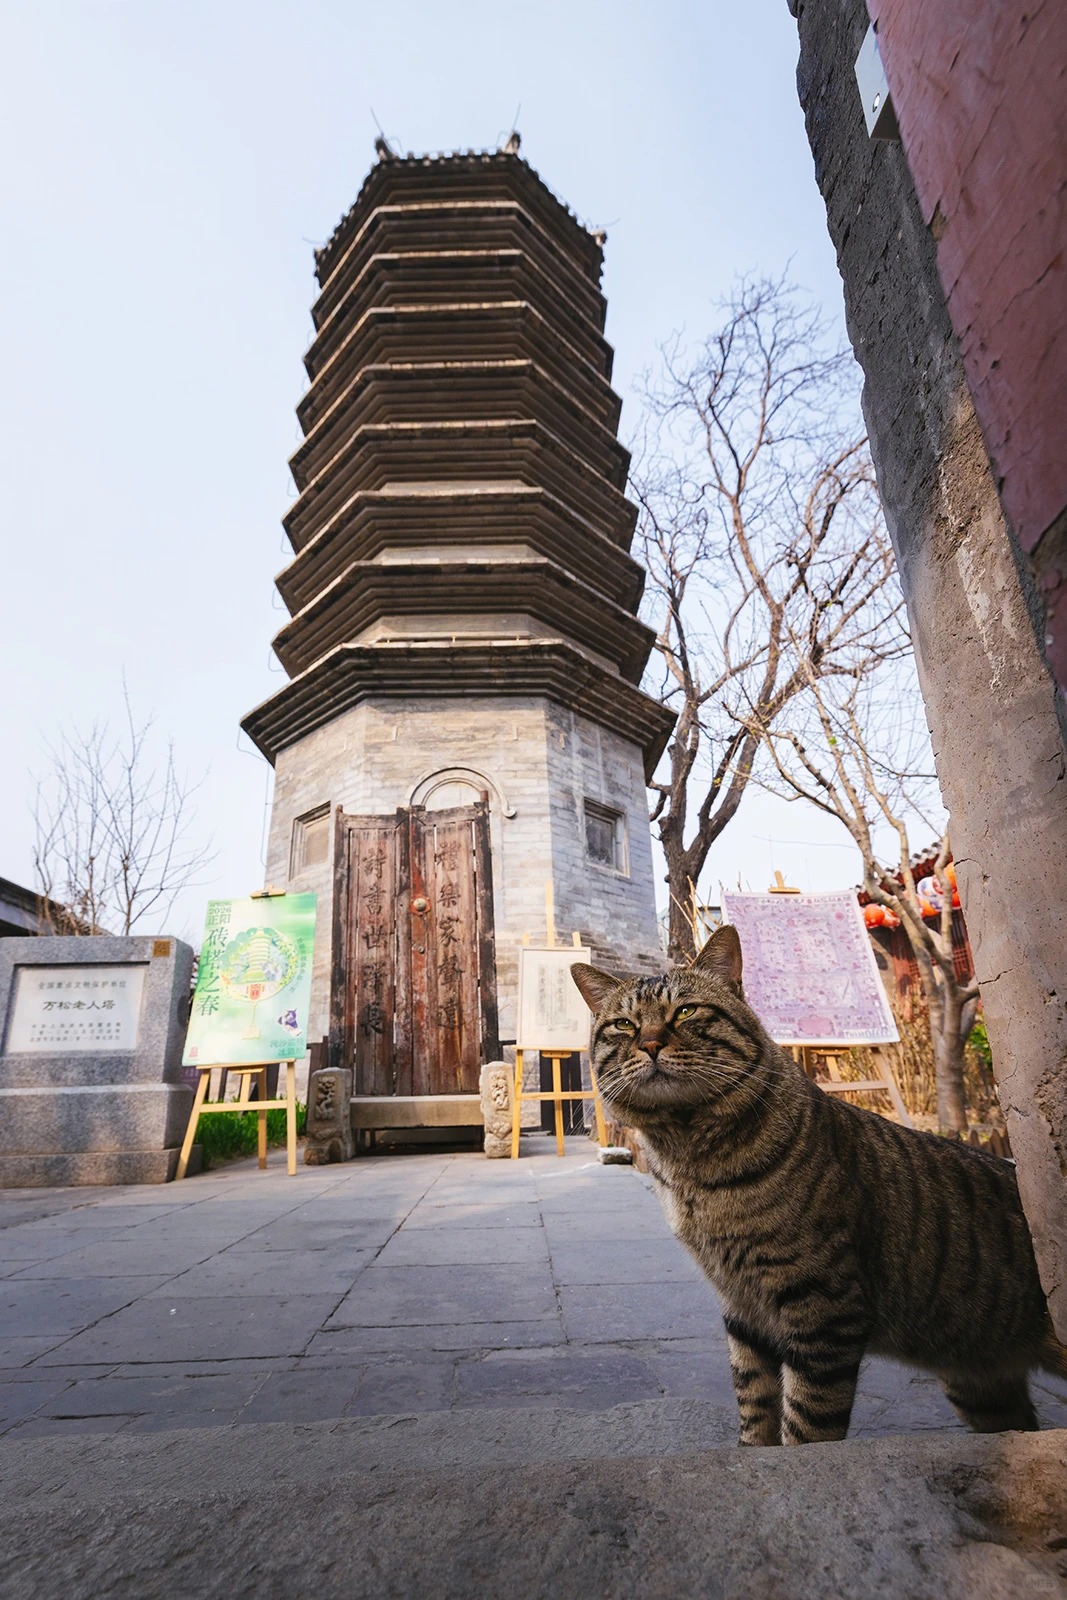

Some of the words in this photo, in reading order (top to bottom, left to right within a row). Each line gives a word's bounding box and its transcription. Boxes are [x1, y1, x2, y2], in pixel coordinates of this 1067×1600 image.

[208, 907, 232, 915] 2026
[196, 927, 229, 1016] 砖塔之春
[42, 999, 116, 1011] 万松老人塔
